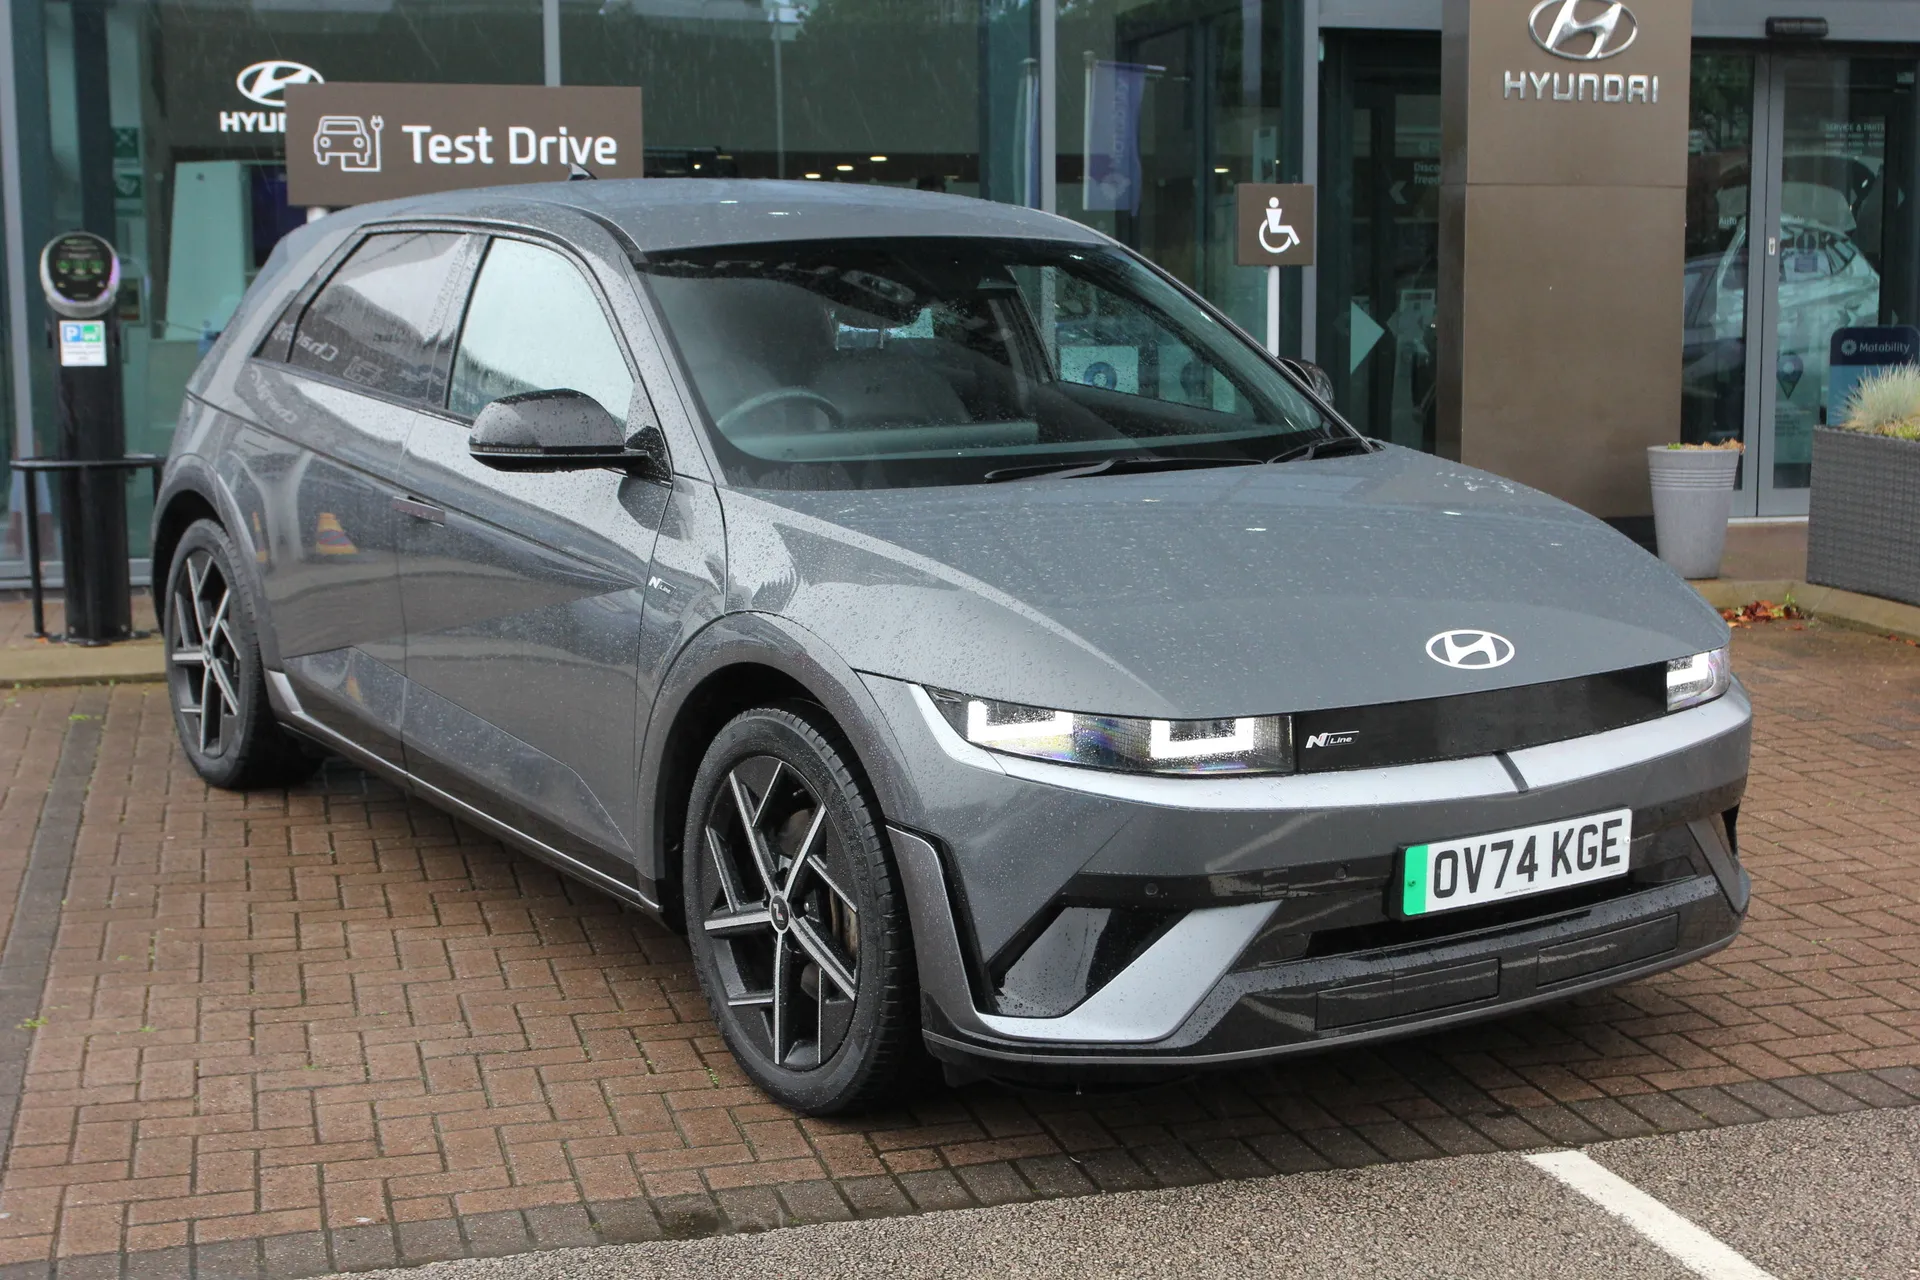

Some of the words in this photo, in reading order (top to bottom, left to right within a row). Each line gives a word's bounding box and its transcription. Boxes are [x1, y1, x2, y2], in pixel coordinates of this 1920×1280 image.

[1504, 70, 1659, 104] HYUNDAI
[402, 125, 494, 165] Test
[509, 126, 618, 166] Drive
[1859, 342, 1910, 355] Motability
[1305, 732, 1329, 749] N
[1433, 835, 1539, 899] OV74
[1551, 818, 1623, 878] KGE
